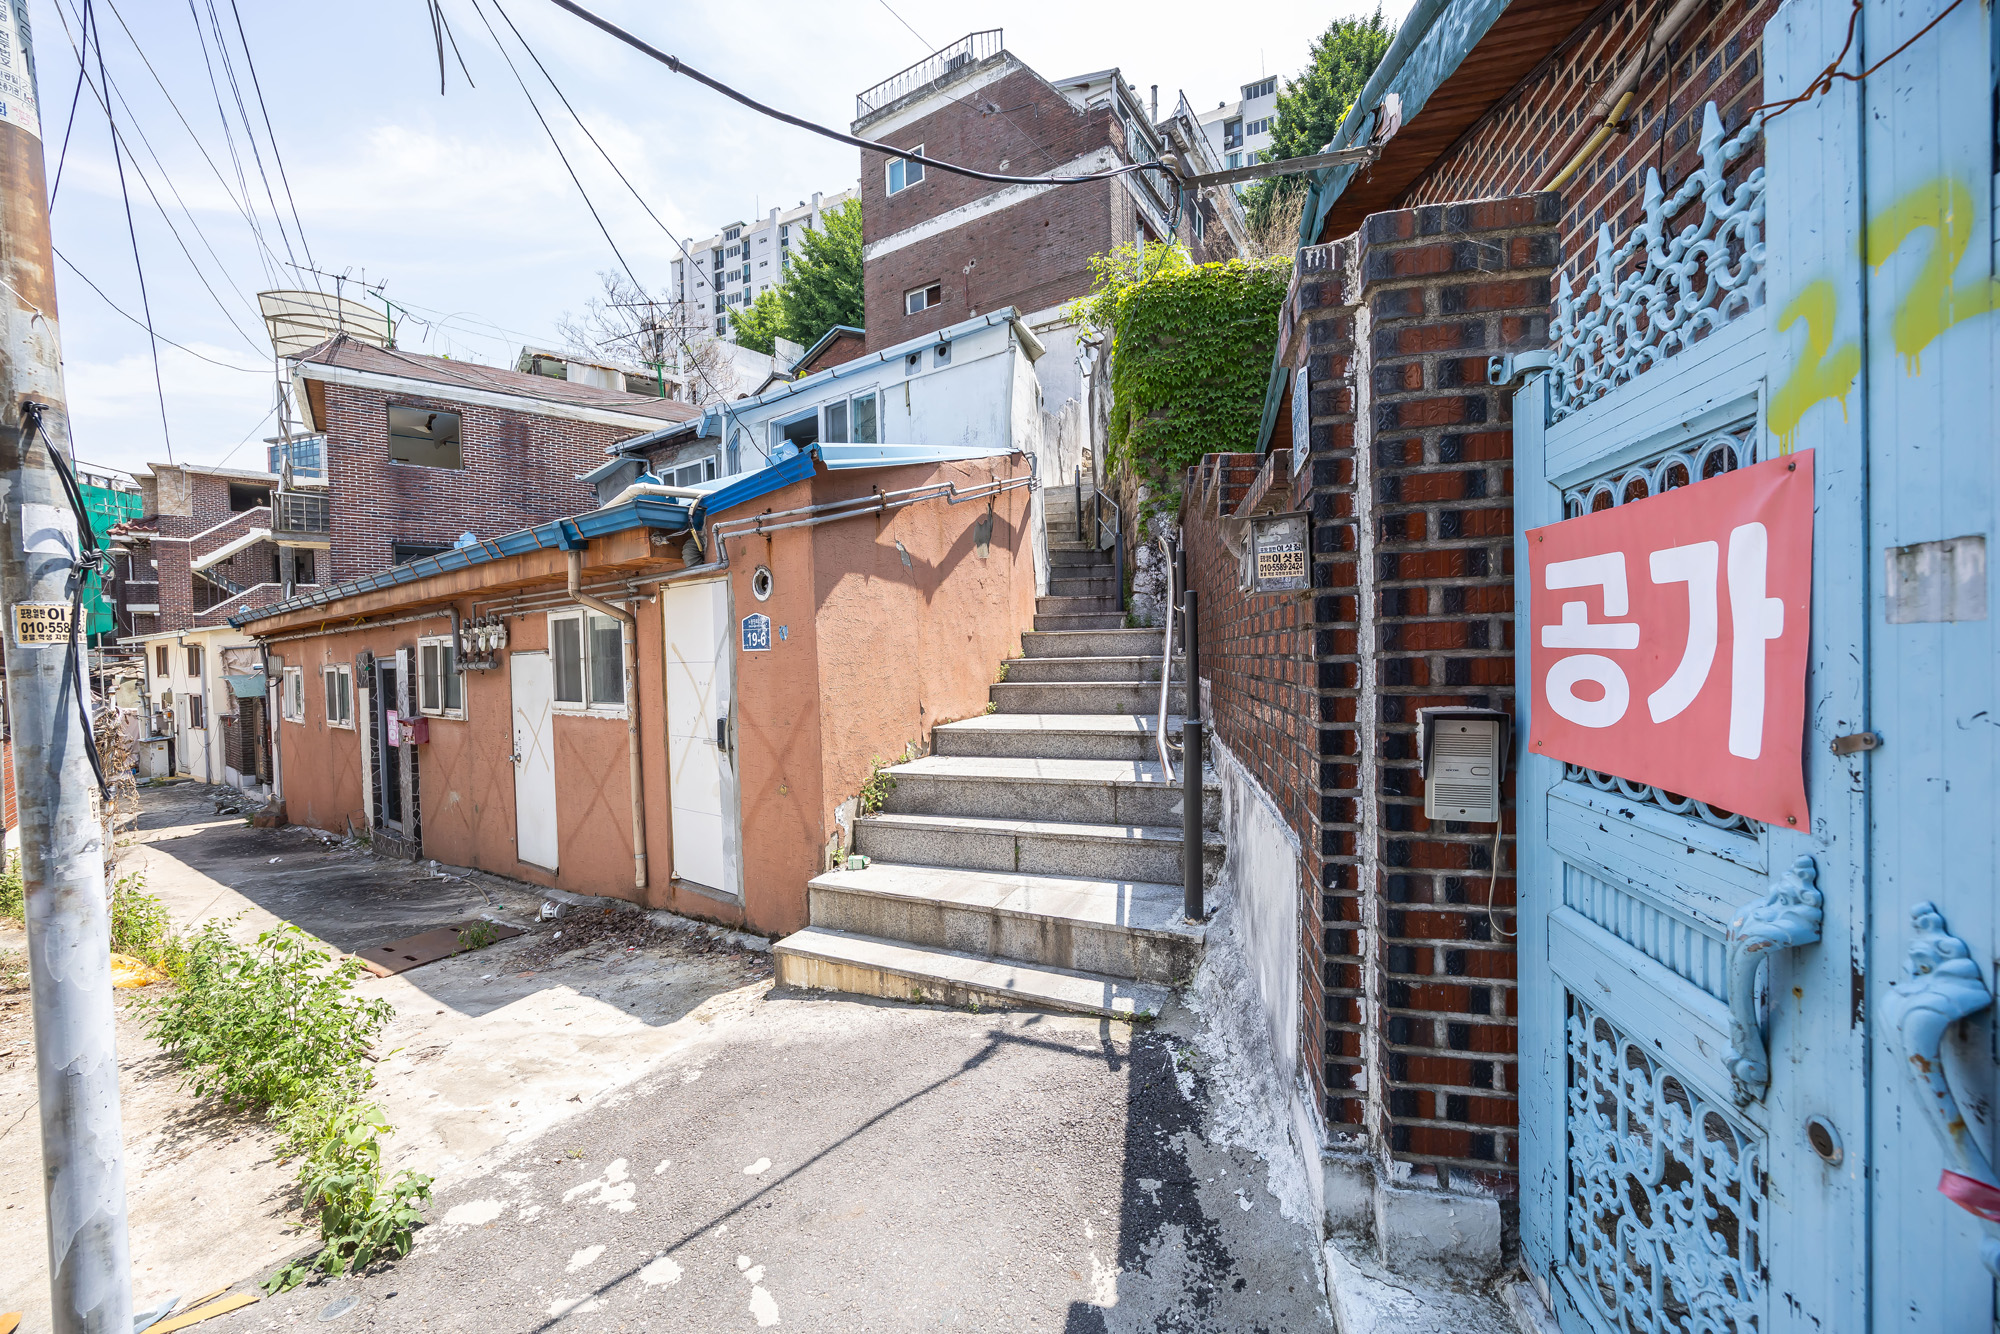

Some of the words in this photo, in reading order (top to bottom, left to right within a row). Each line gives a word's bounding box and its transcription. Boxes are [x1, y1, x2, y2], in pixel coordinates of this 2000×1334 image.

[1272, 553, 1303, 564] 이삿짐
[747, 632, 767, 647] 19-6
[1541, 522, 1784, 760] 공가
